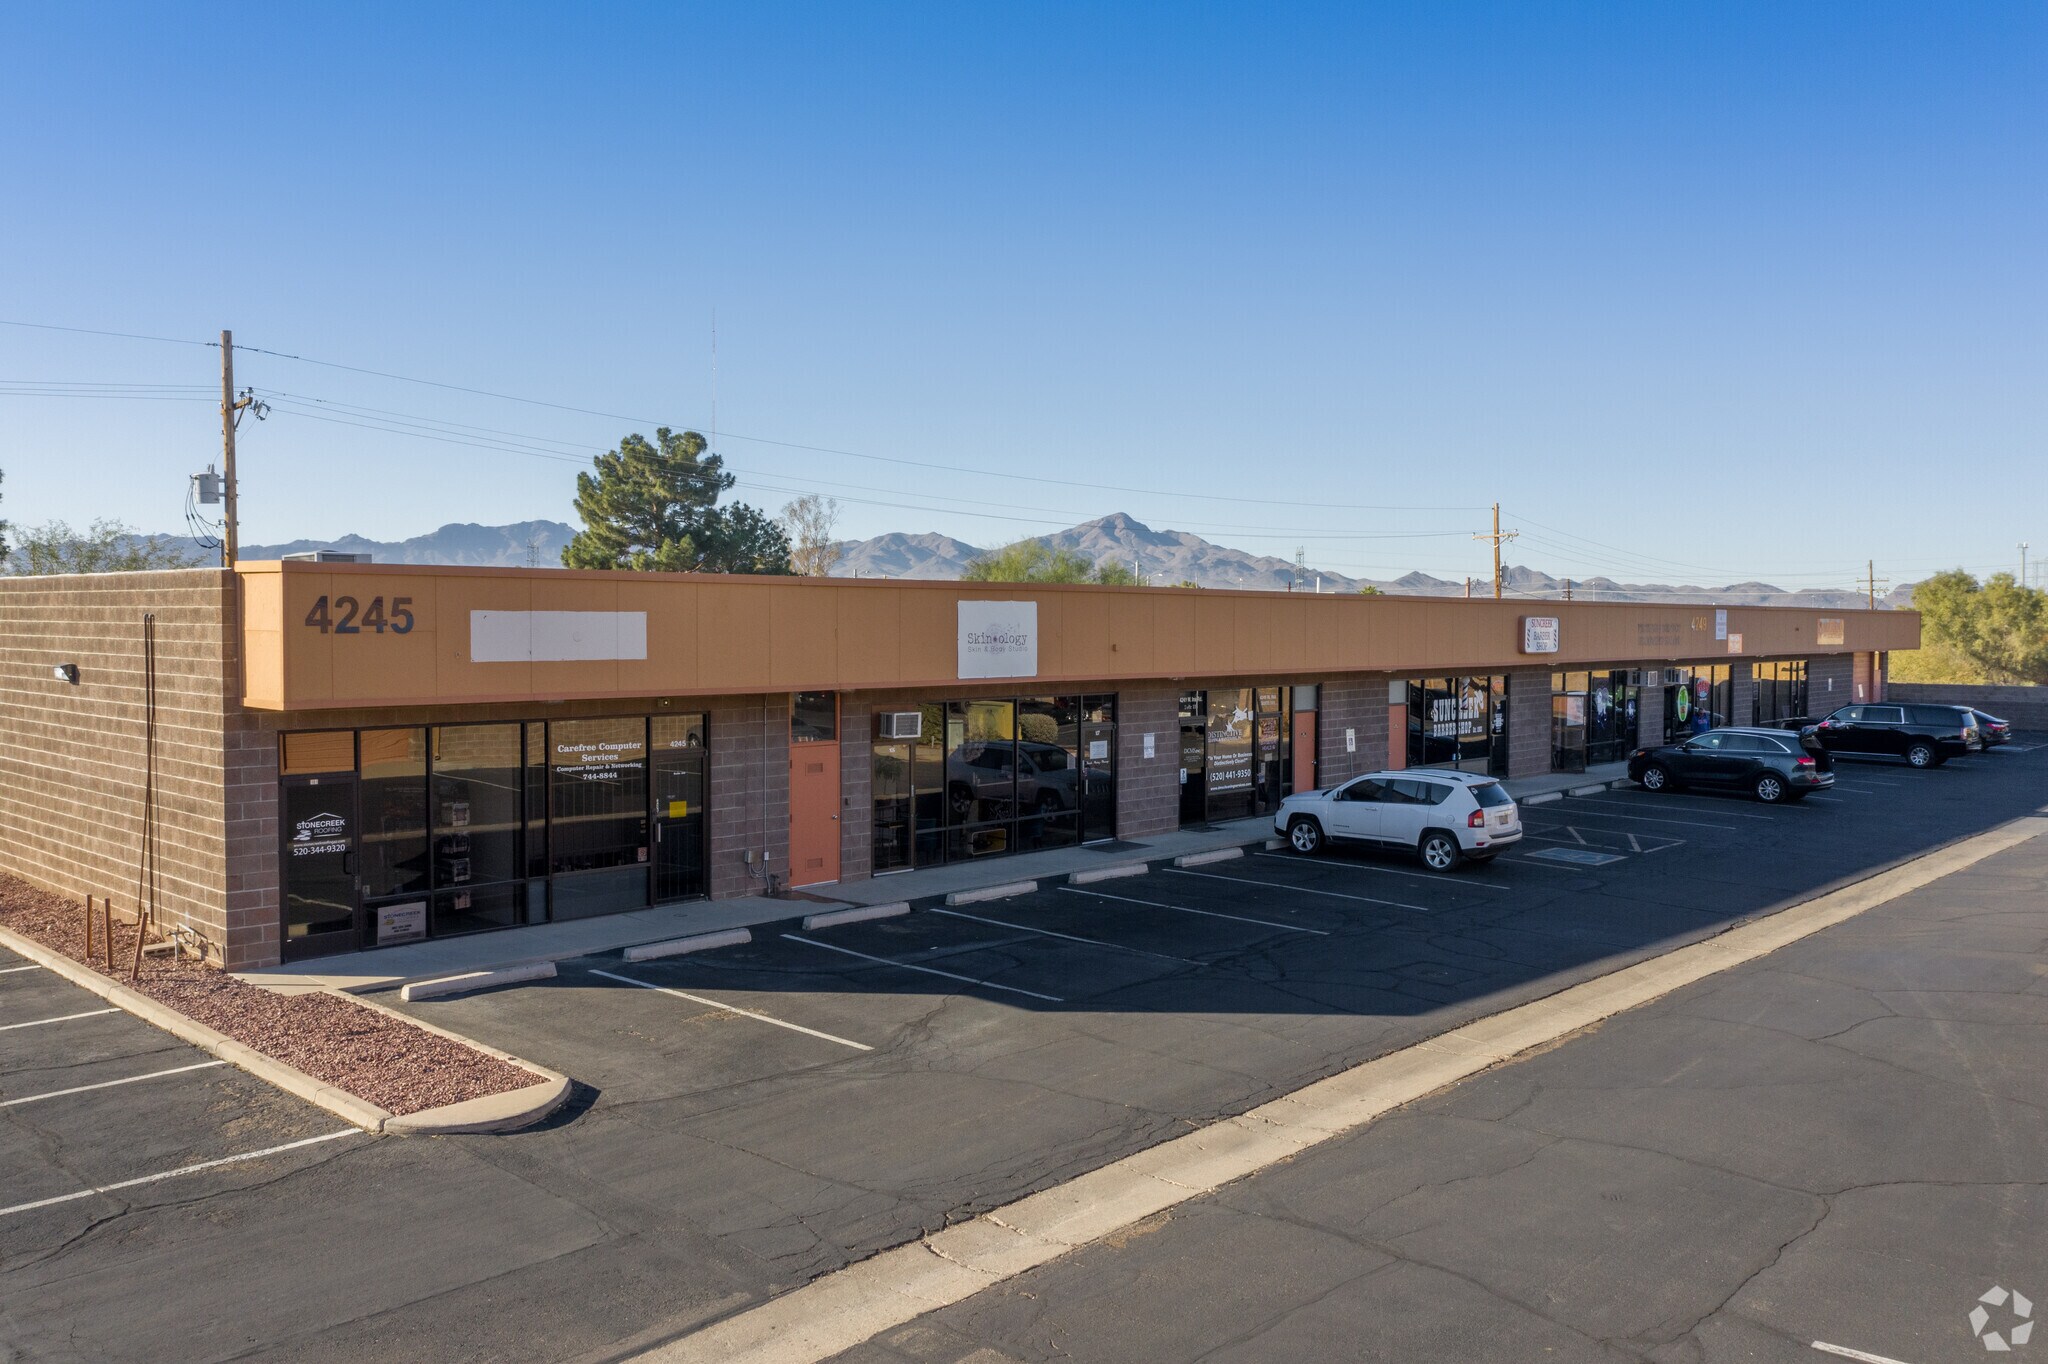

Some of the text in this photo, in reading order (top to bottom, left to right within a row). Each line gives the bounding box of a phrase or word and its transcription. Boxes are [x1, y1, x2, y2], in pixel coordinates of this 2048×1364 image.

[305, 596, 414, 634] 4245
[1691, 617, 1707, 631] 4249
[1207, 730, 1242, 739] DISTINCTIVE
[1433, 722, 1457, 737] BARBER
[557, 742, 641, 753] Carefree Computer
[581, 753, 619, 762] Services
[582, 772, 617, 780] 744-8844
[1210, 769, 1252, 782] (520) 441-9350
[296, 819, 345, 830] STONECREEK
[314, 826, 342, 834] ROOFING
[293, 843, 346, 856] 520-344-9320
